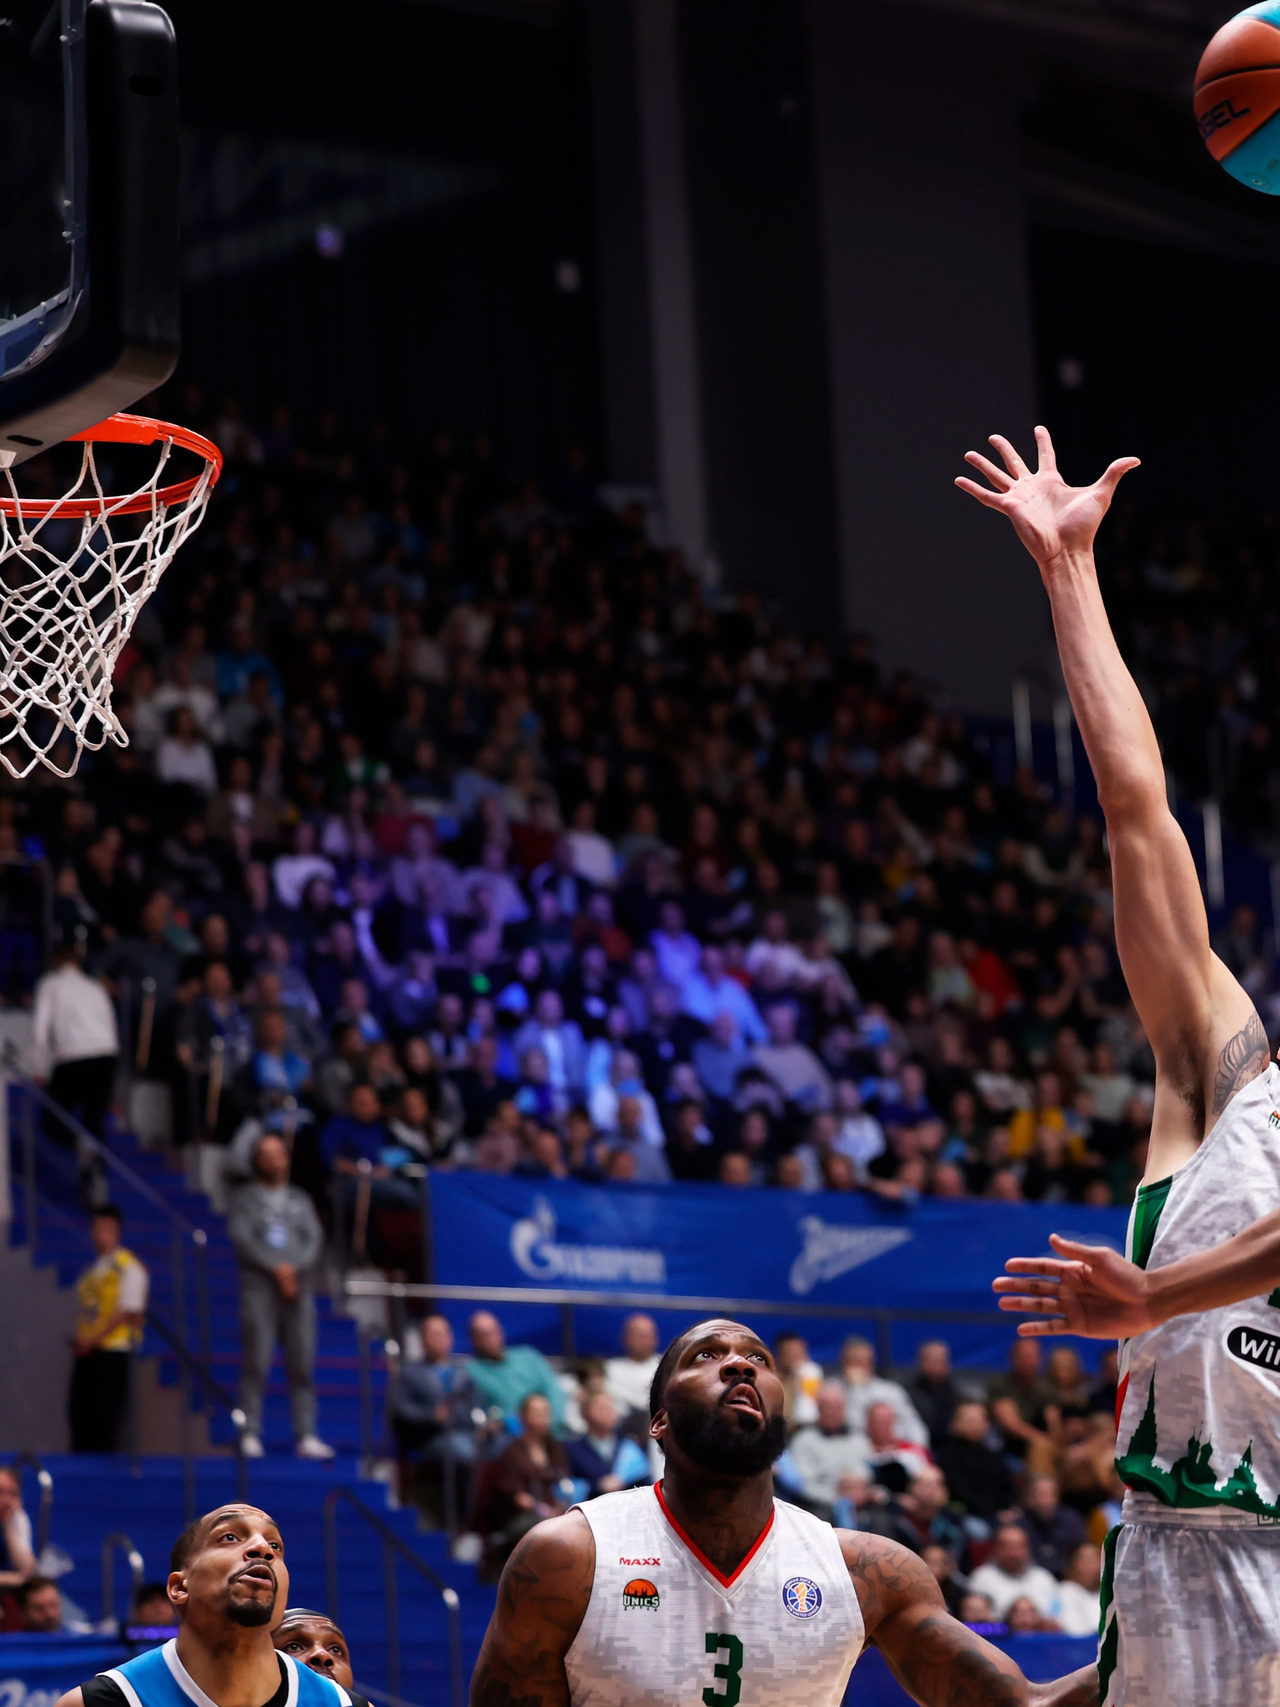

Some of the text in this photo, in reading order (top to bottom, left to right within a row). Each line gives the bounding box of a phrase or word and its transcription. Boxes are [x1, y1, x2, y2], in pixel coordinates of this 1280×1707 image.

[1198, 98, 1252, 138] GEL
[619, 1557, 661, 1566] MAXX
[623, 1594, 660, 1608] UNICS
[703, 1634, 743, 1707] 3
